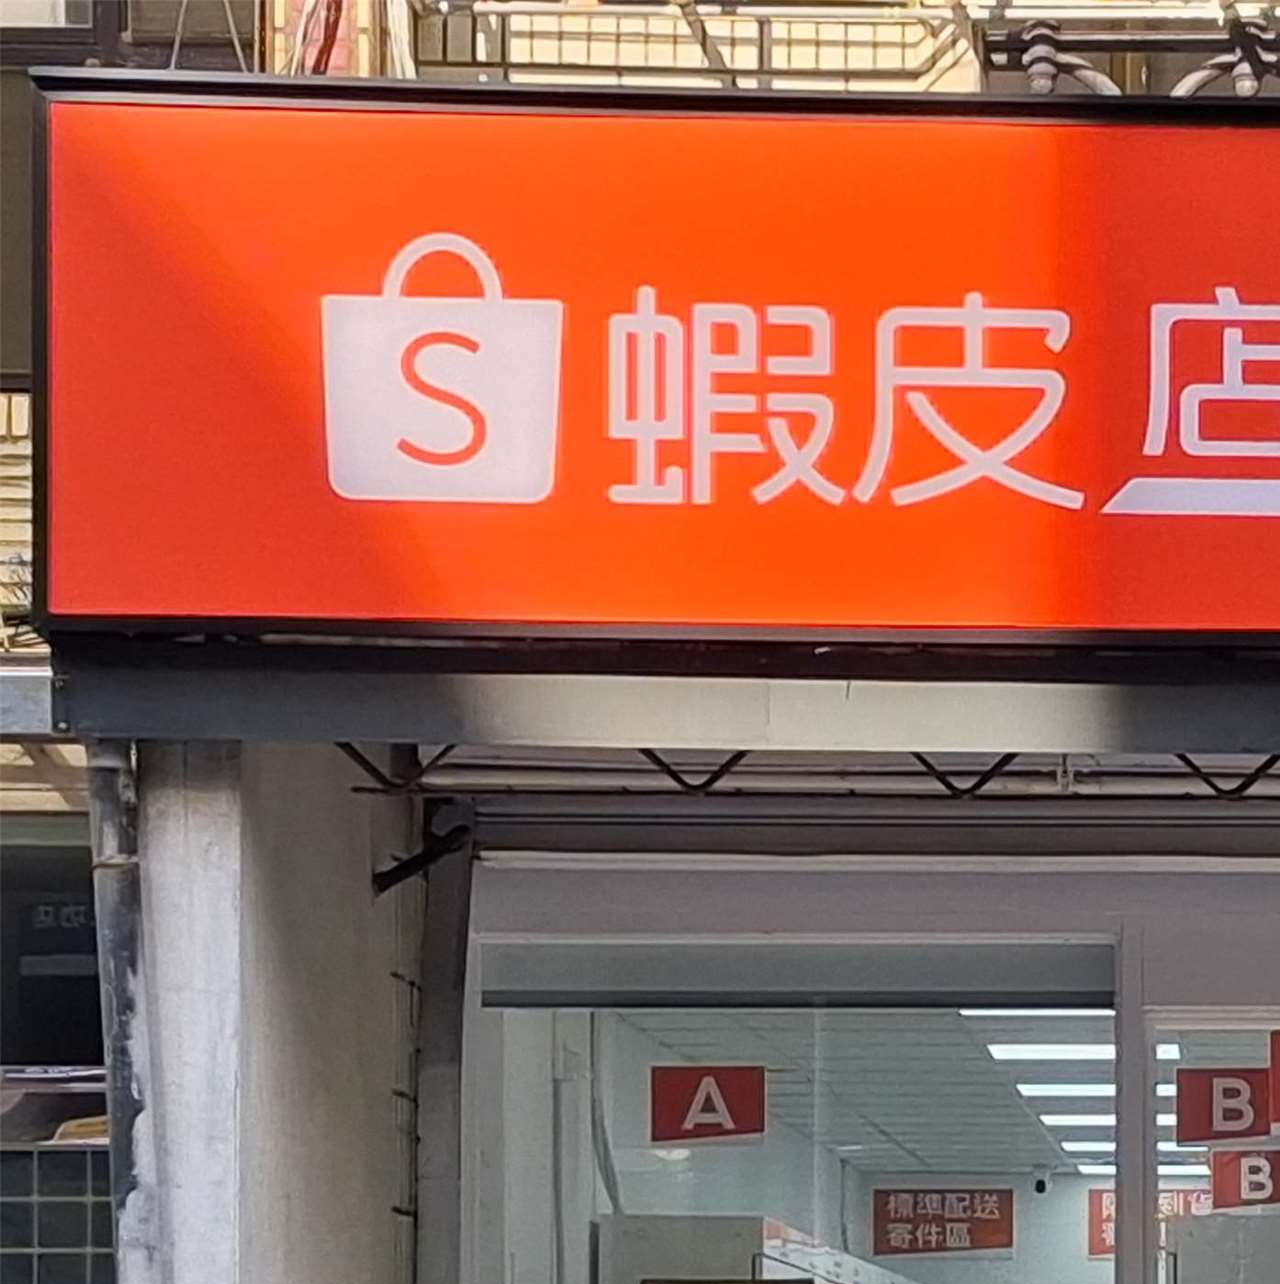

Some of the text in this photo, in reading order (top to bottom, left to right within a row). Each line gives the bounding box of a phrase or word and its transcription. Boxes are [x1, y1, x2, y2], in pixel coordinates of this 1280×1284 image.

[396, 330, 487, 467] S
[607, 285, 1086, 508] 蝦皮
[681, 1074, 736, 1130] A
[1211, 1077, 1255, 1132] B
[887, 1191, 1000, 1219] 標準配送
[1240, 1156, 1273, 1200] B
[887, 1222, 972, 1249] 寄件區
